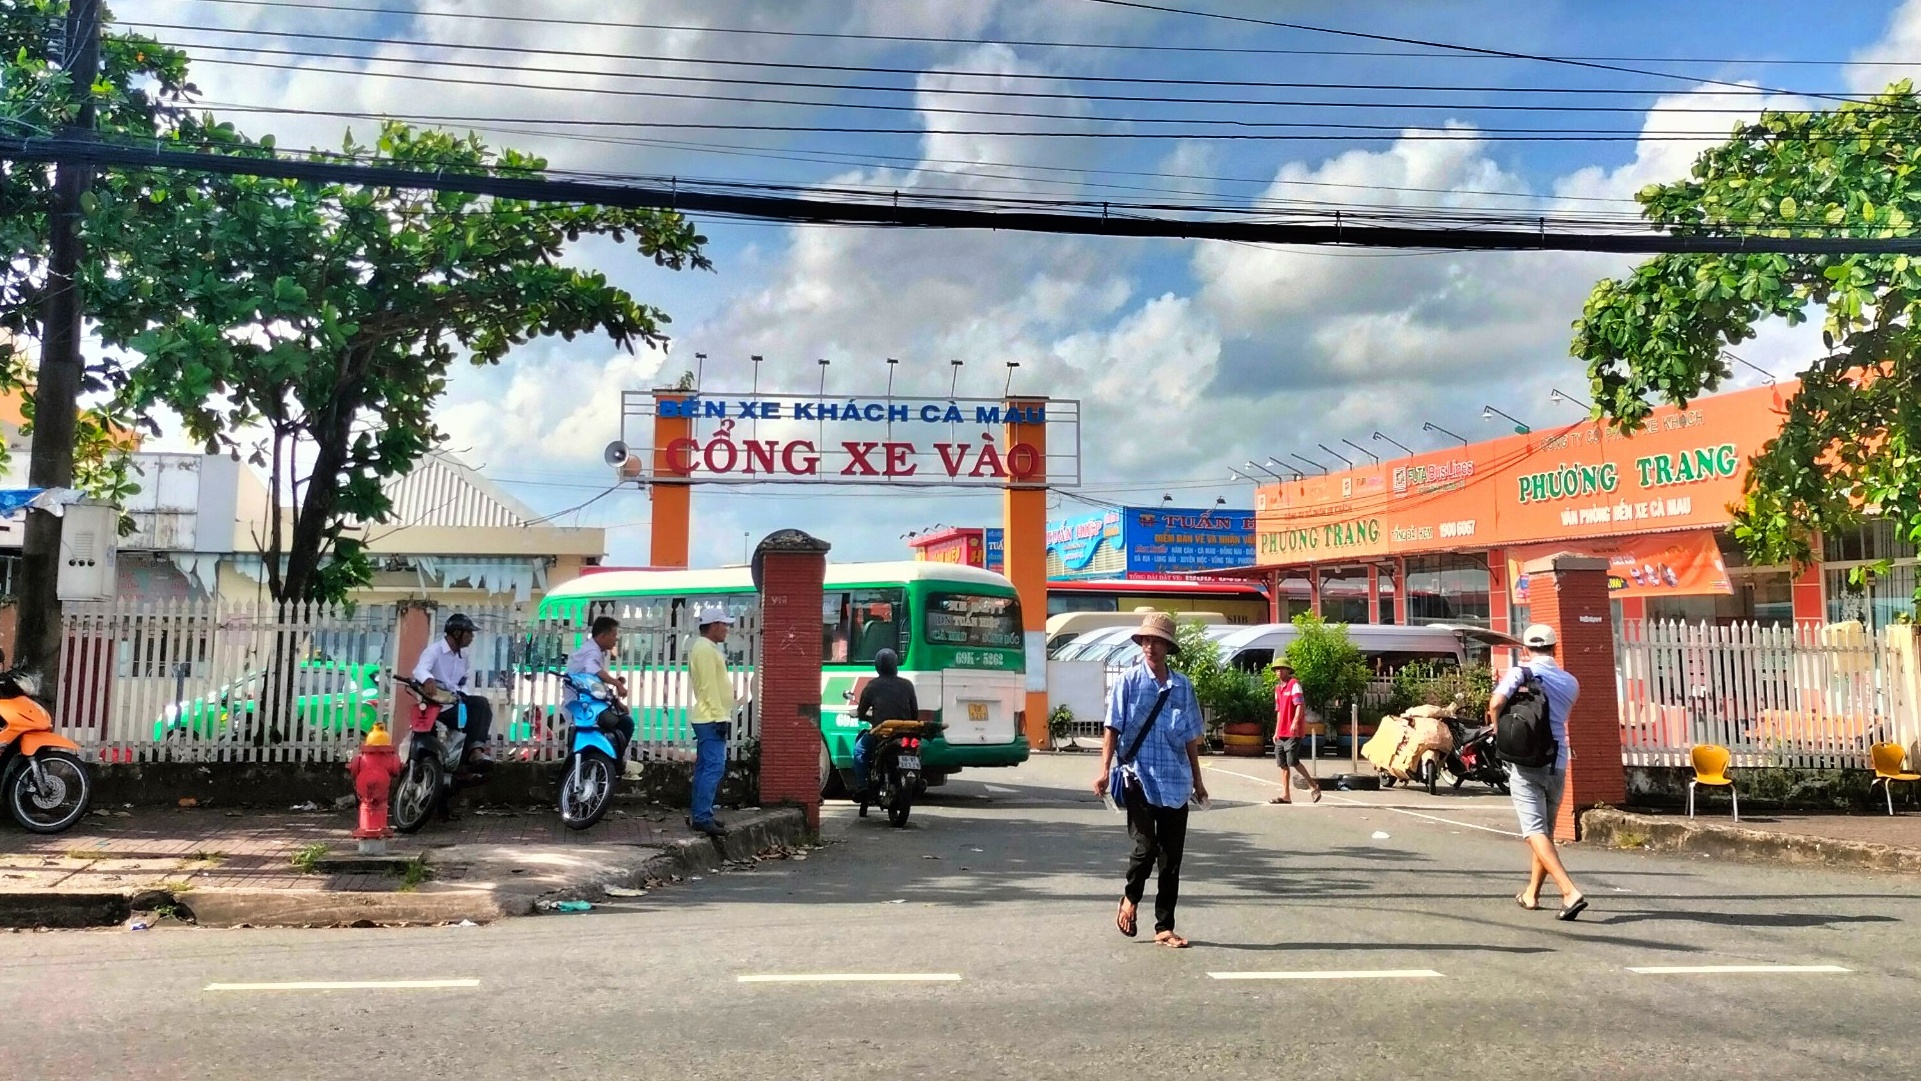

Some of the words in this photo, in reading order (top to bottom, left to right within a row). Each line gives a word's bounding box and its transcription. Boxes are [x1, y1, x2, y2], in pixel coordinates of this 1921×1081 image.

[659, 394, 726, 418] BẾN
[738, 402, 781, 419] XE
[794, 398, 909, 422] KHÁCH
[920, 400, 964, 423] CÀ
[976, 406, 1045, 425] MAU
[666, 419, 820, 475] CỔNG
[840, 441, 918, 476] XE
[933, 432, 1040, 479] VÀO
[1518, 461, 1619, 503] PHƯƠNG
[1636, 443, 1740, 488] TRANG
[1161, 509, 1232, 529] TUẤN
[1635, 503, 1649, 520] XE
[1650, 497, 1665, 518] CÀ
[1666, 496, 1692, 516] MAU
[1324, 518, 1380, 547] TRANG
